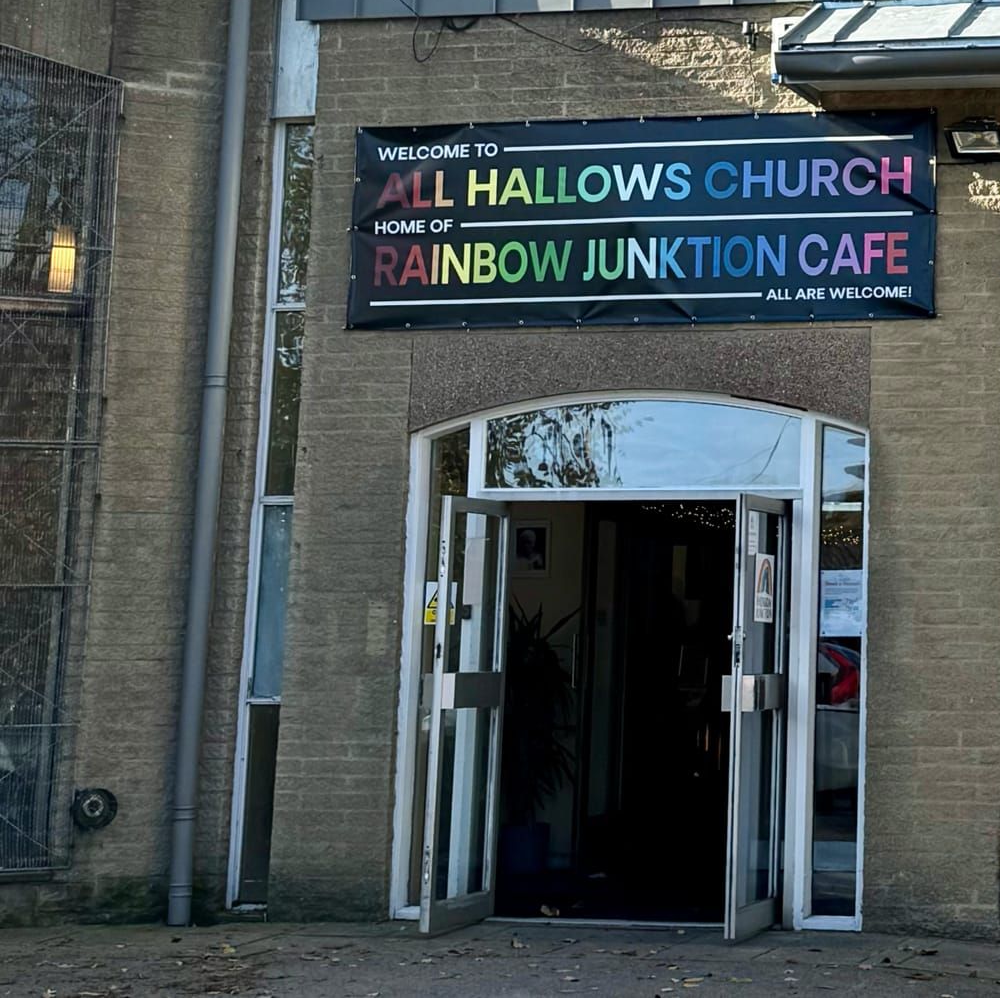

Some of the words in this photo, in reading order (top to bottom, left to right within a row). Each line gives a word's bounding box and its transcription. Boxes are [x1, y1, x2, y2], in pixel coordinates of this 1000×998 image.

[377, 144, 470, 161] WELCOME
[474, 143, 498, 157] TO
[376, 170, 454, 209] ALL
[467, 162, 692, 206] HALLOWS
[704, 156, 912, 199] CHURCH
[374, 220, 425, 235] HOME
[429, 219, 454, 233] OF
[373, 240, 573, 287] RAINBOW
[583, 234, 786, 282] JUNKTION
[798, 232, 909, 276] CAFE
[766, 288, 792, 300] ALL
[795, 287, 826, 300] ARE
[829, 286, 912, 299] WELCOME!
